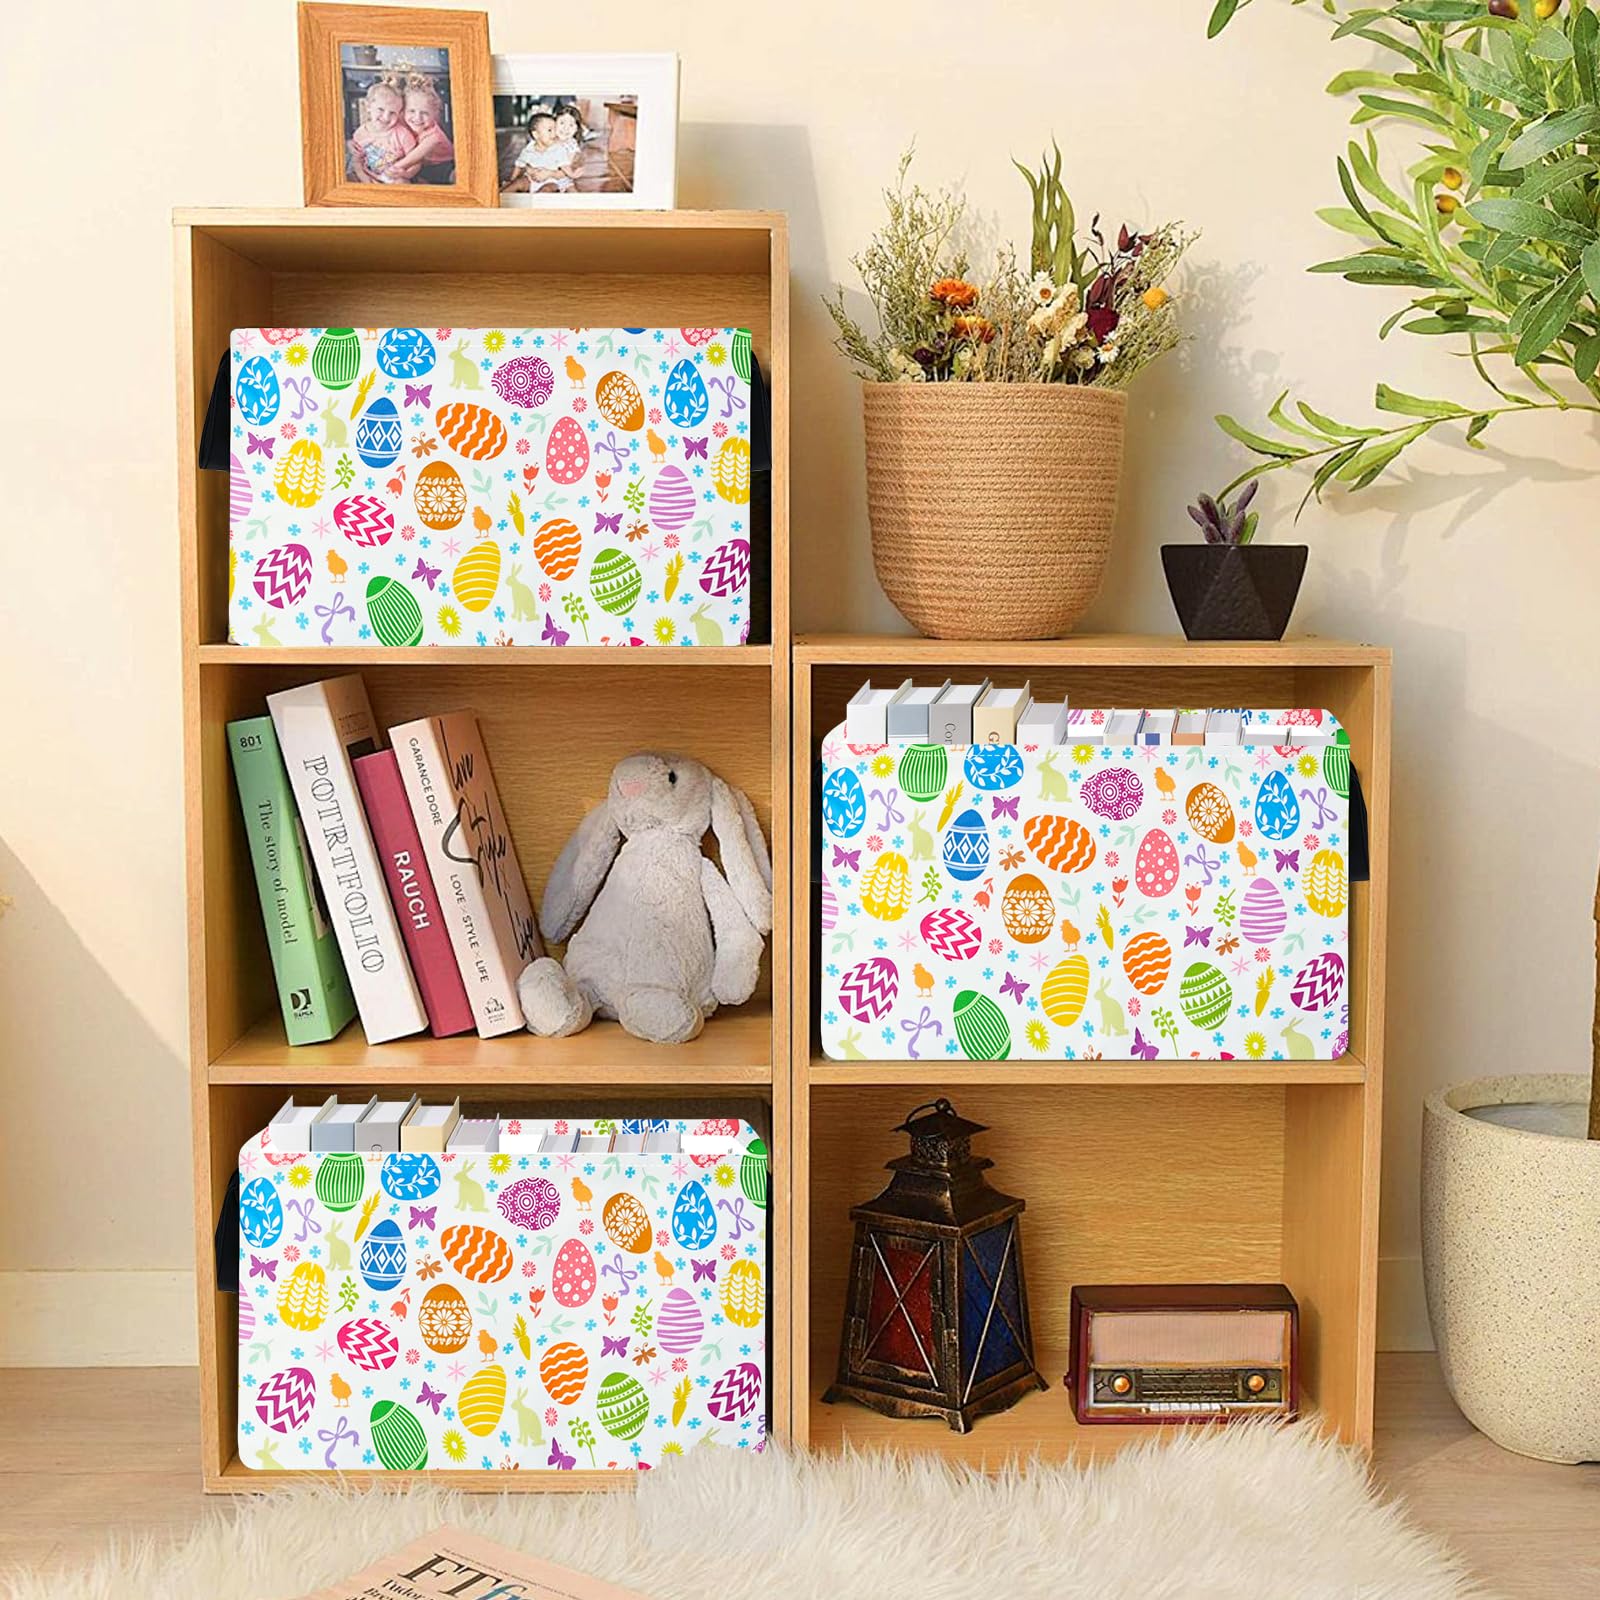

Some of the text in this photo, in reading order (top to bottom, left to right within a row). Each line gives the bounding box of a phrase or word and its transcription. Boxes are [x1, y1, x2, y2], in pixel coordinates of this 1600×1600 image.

[239, 735, 262, 748] 801
[409, 737, 443, 826] GARANCE DORE
[258, 799, 298, 945] The story of model
[303, 754, 385, 973] POTRTFOLIO
[393, 851, 430, 930] RAUCH
[450, 873, 490, 984] LOVE STYLE LIFE
